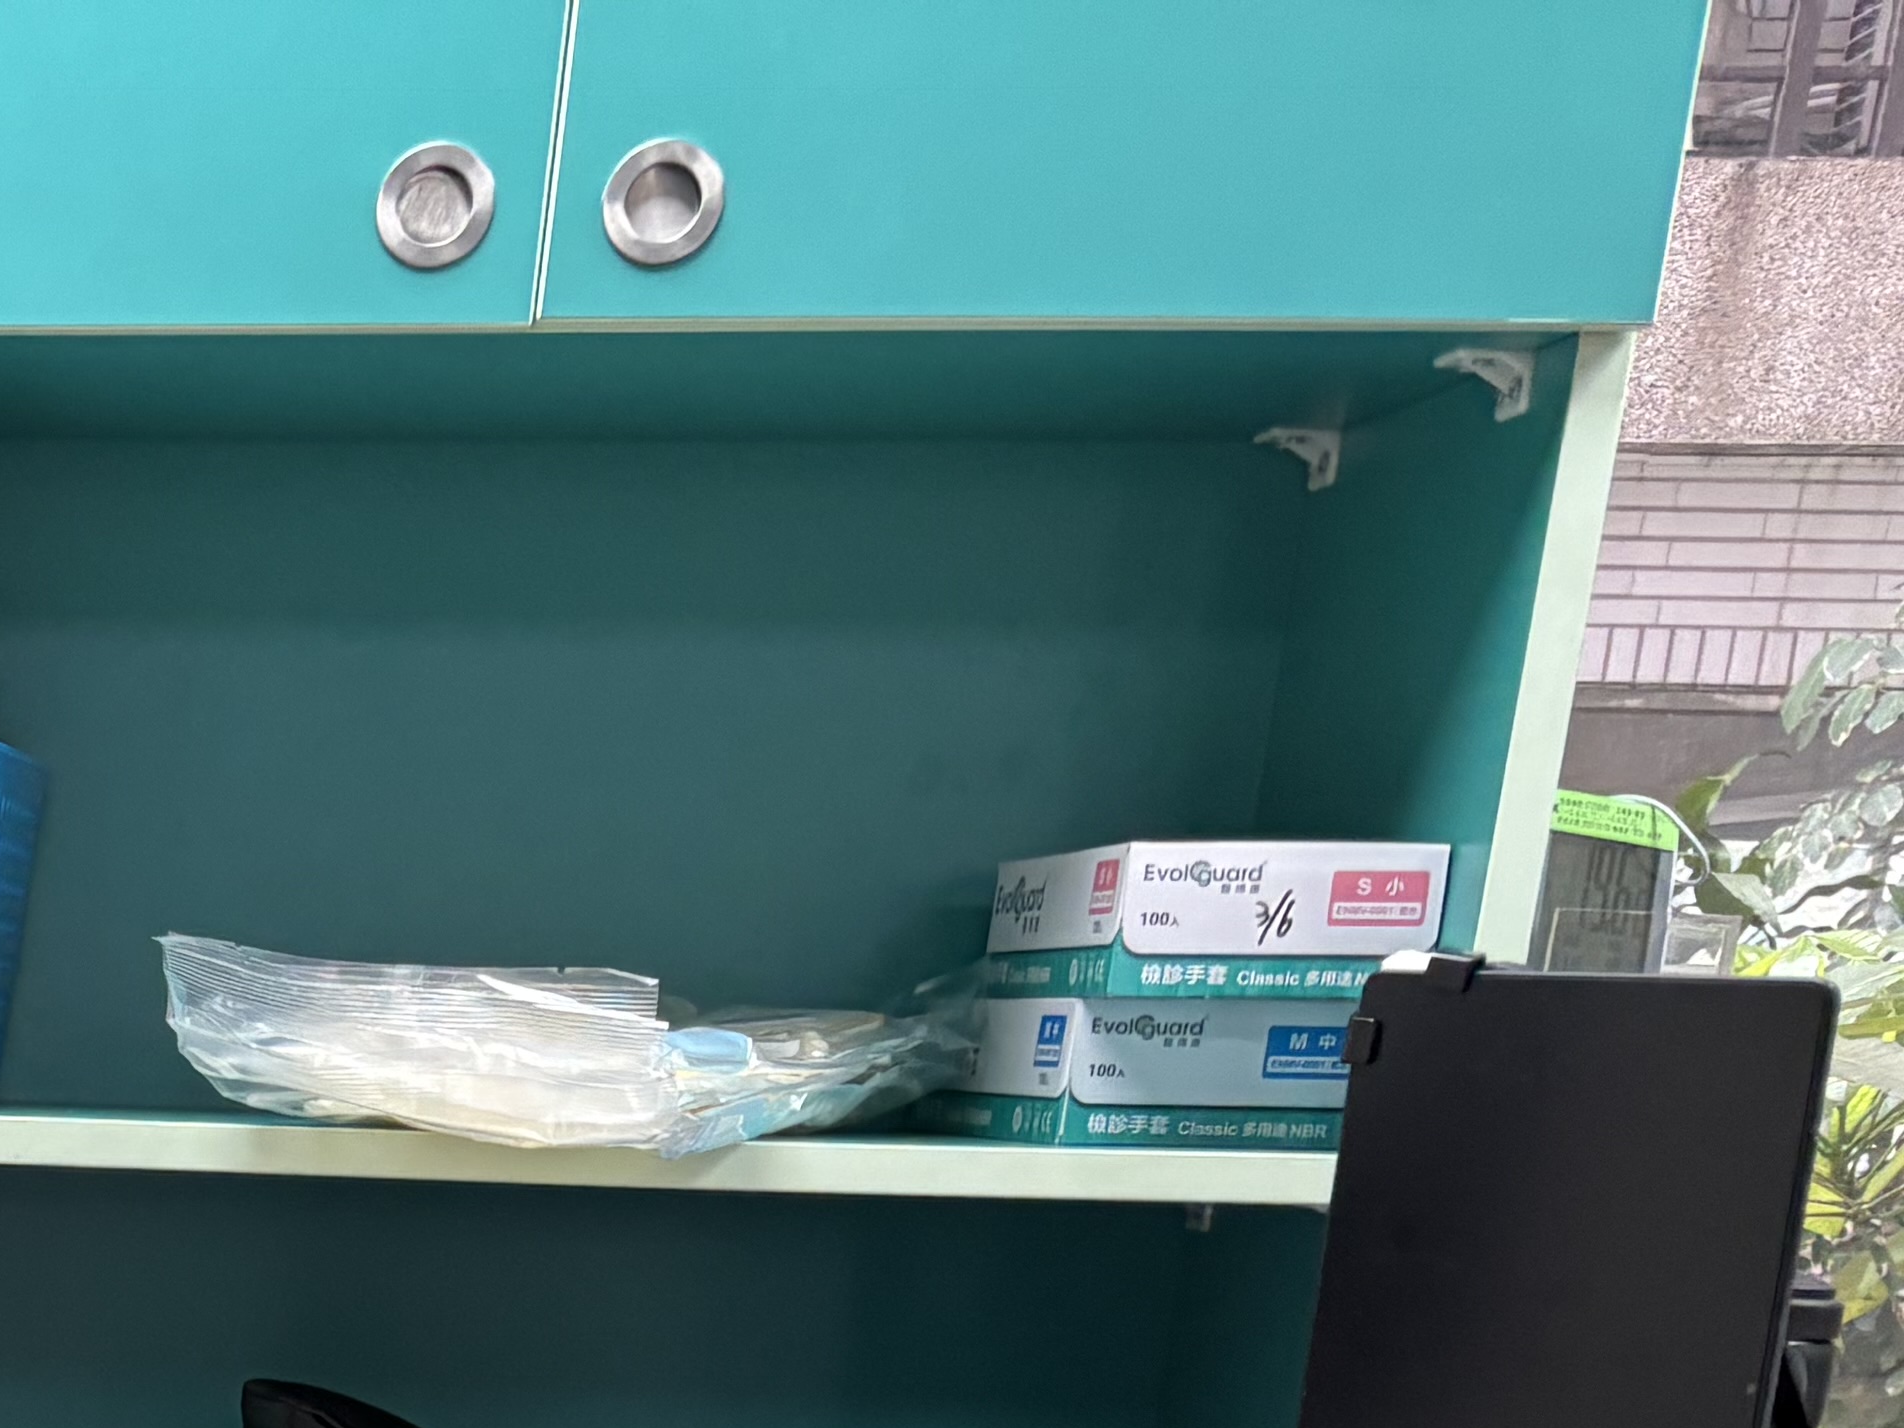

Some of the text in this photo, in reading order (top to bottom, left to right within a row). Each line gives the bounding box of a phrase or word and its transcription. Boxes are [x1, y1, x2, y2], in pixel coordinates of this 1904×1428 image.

[1357, 876, 1406, 896] S 小
[1236, 970, 1300, 988] Classic
[1289, 1033, 1337, 1051] M 中
[1177, 1120, 1238, 1138] Classic
